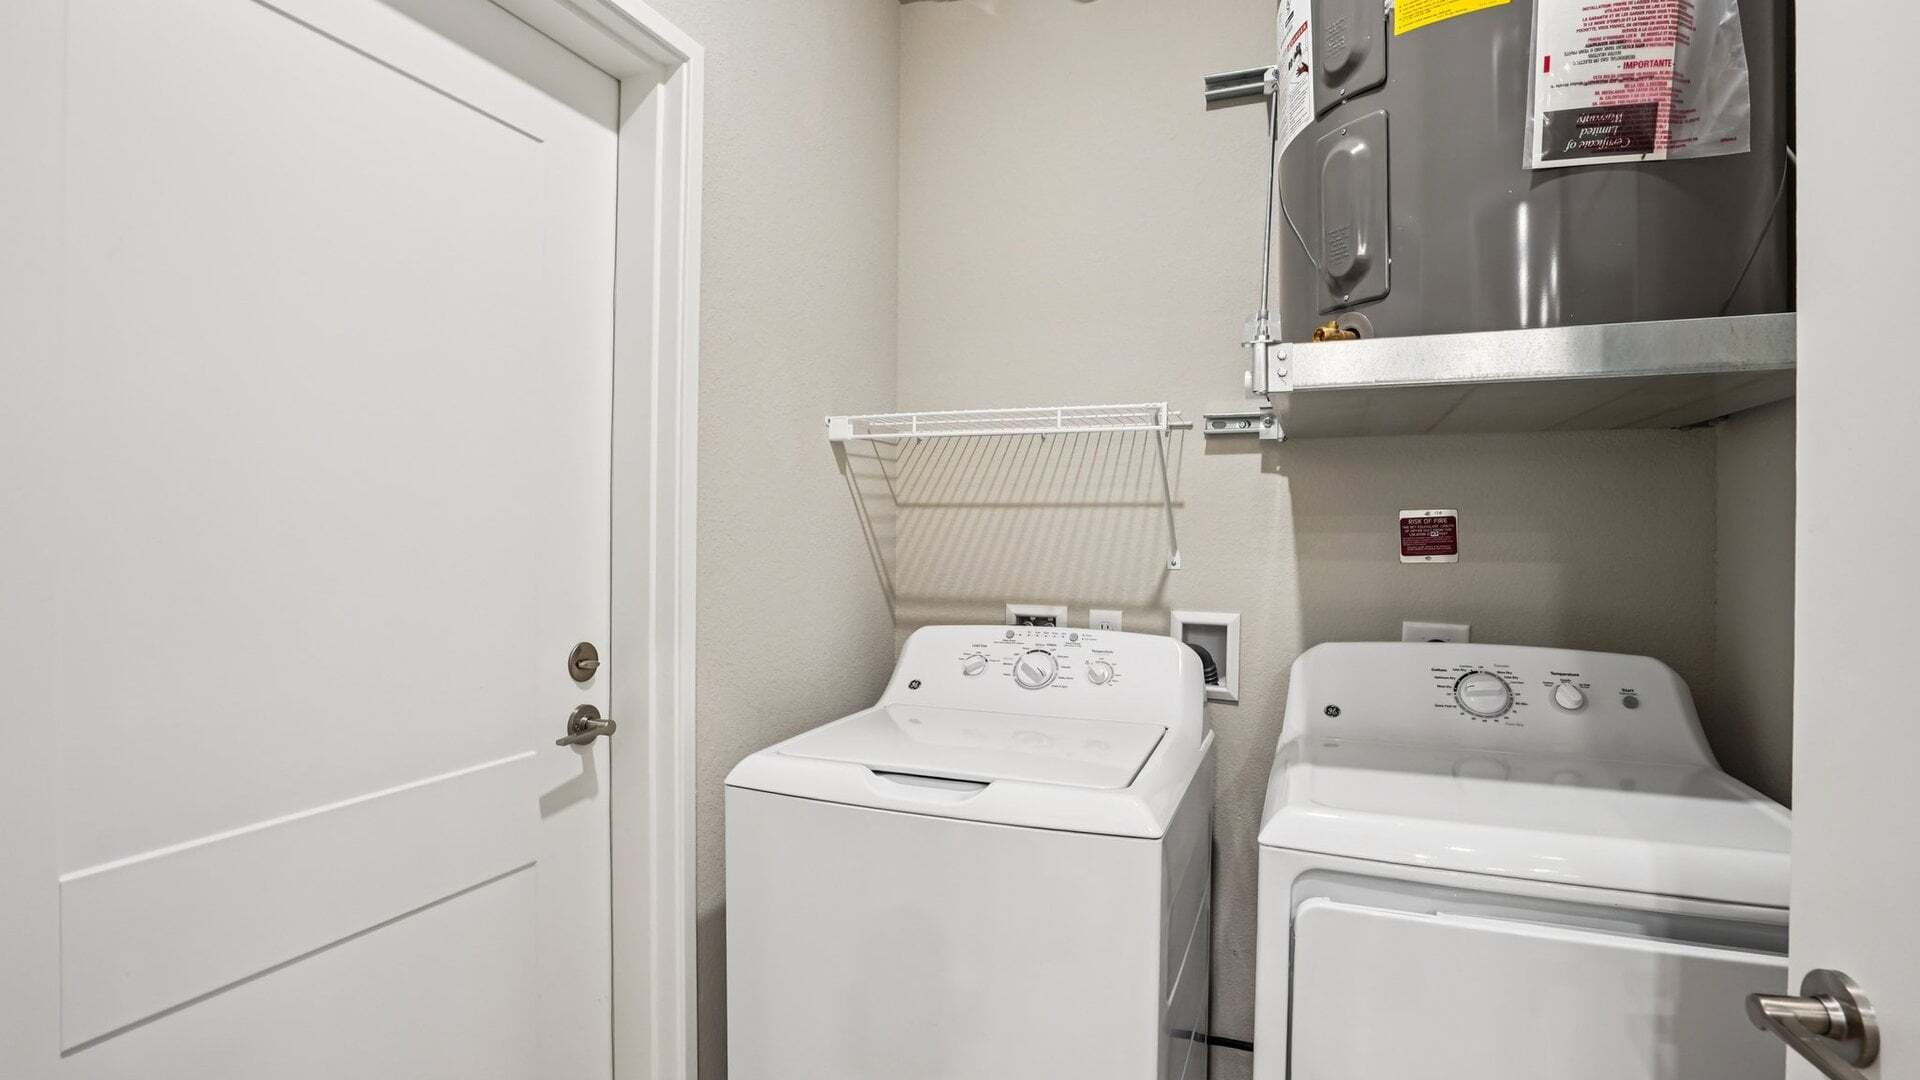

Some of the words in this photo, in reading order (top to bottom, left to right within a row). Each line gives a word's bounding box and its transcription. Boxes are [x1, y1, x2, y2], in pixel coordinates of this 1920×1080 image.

[1623, 59, 1672, 70] IMPORTANTE
[1579, 125, 1619, 138] Limited
[1564, 139, 1577, 152] of
